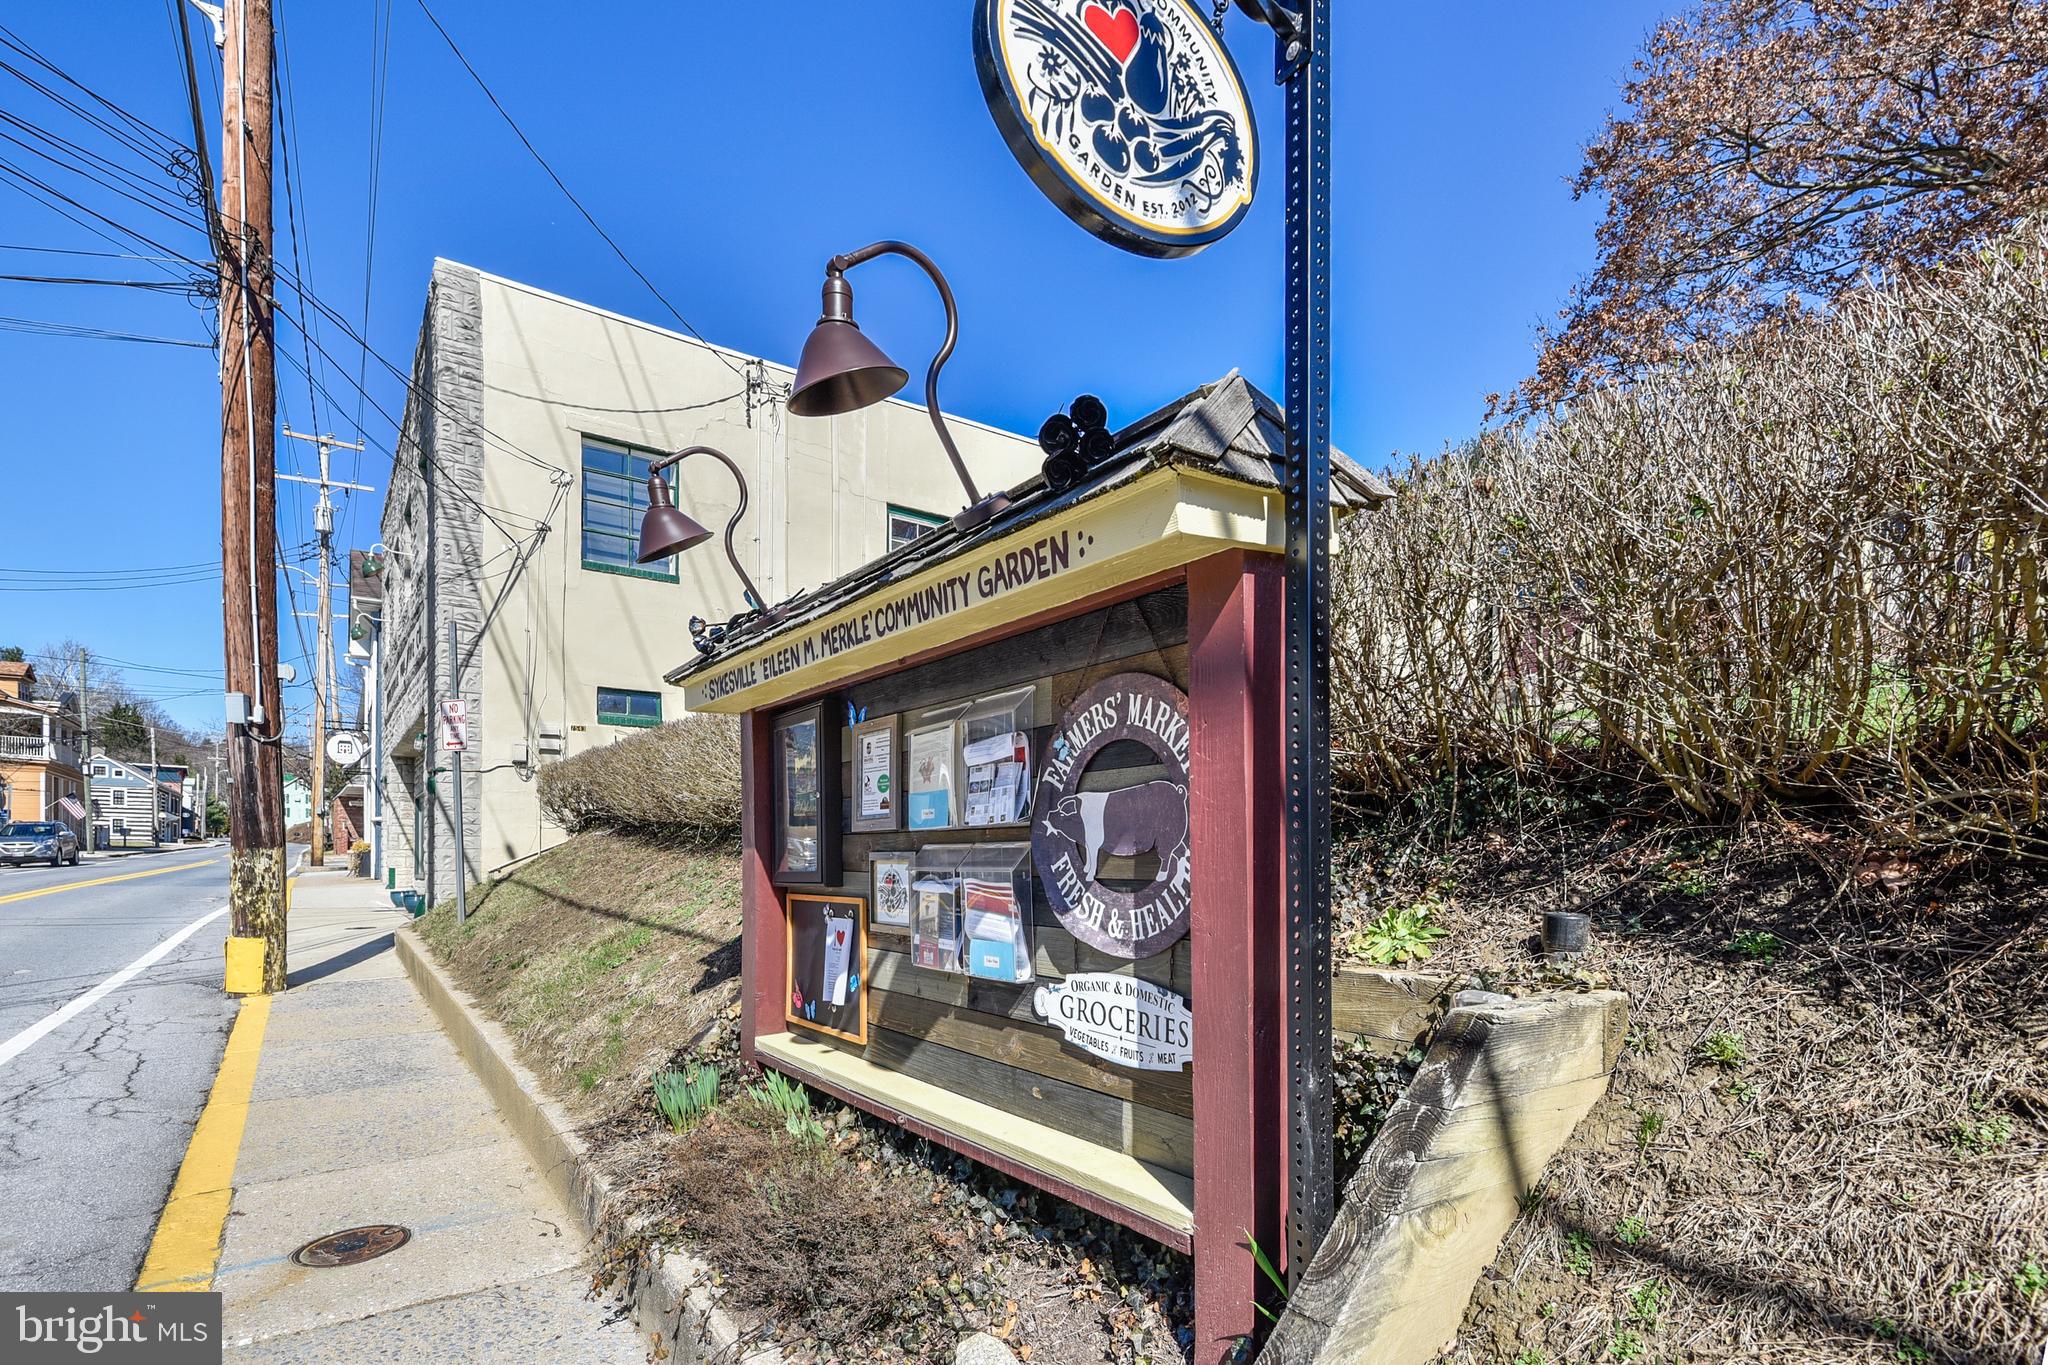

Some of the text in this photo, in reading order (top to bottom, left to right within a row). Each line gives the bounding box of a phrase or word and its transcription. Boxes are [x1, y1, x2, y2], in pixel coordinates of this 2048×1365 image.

[1156, 0, 1218, 103] OMMUNITY
[1069, 133, 1198, 215] GARDEN EST. 2012
[708, 660, 757, 701] SYKESVILLE
[803, 638, 819, 666] M.
[874, 571, 971, 636] COMMUNITY
[977, 530, 1070, 600] GARDEN
[442, 714, 465, 725] PARKING
[448, 703, 459, 714] NO
[1051, 852, 1106, 932] FRESH
[1107, 908, 1125, 940] &
[1113, 981, 1123, 995] &
[1060, 995, 1189, 1048] GROCERIES
[1069, 1025, 1177, 1065] VEGETABLES FRUITS MEAT
